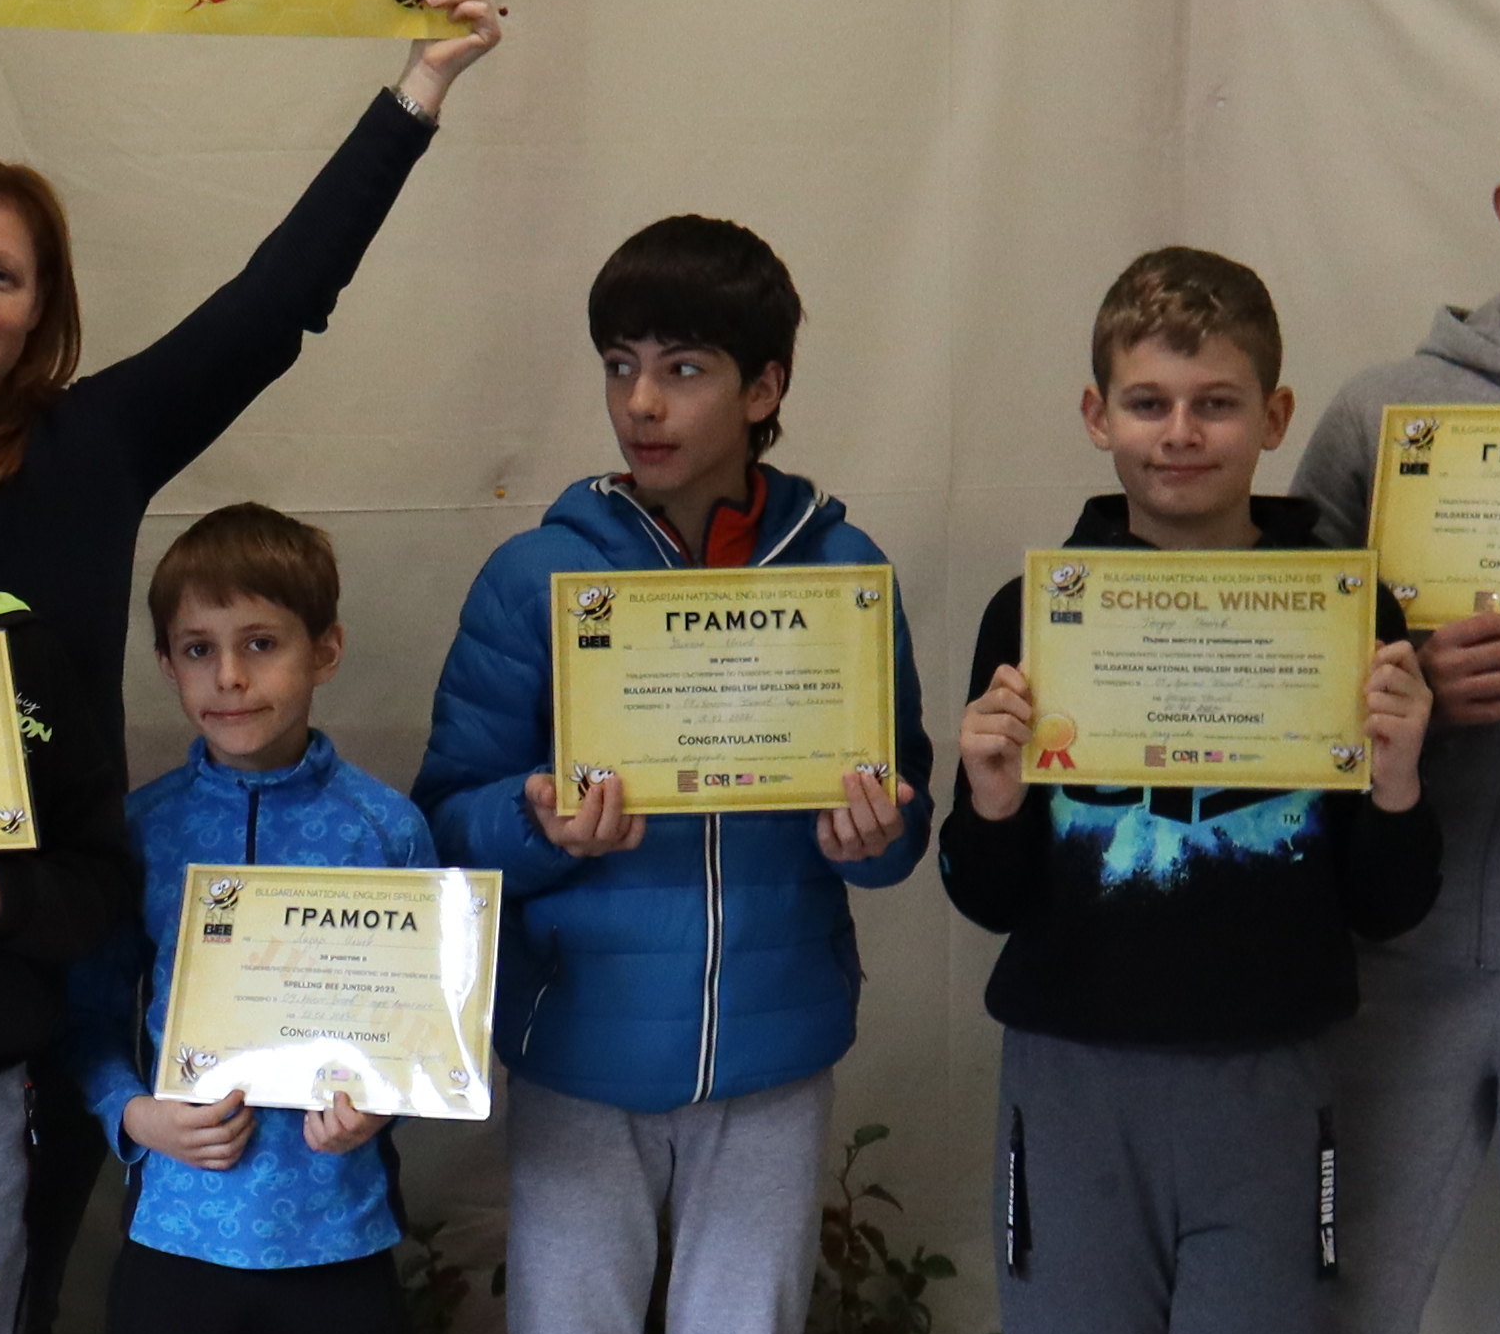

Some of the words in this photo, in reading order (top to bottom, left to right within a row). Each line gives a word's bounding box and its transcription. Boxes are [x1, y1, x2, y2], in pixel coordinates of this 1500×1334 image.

[1100, 590, 1208, 610] SCHOOL
[1218, 590, 1326, 611] WINNER
[665, 608, 807, 633] ГРАМОТА
[202, 922, 234, 936] BEE
[283, 906, 419, 931] ГРАМОТА
